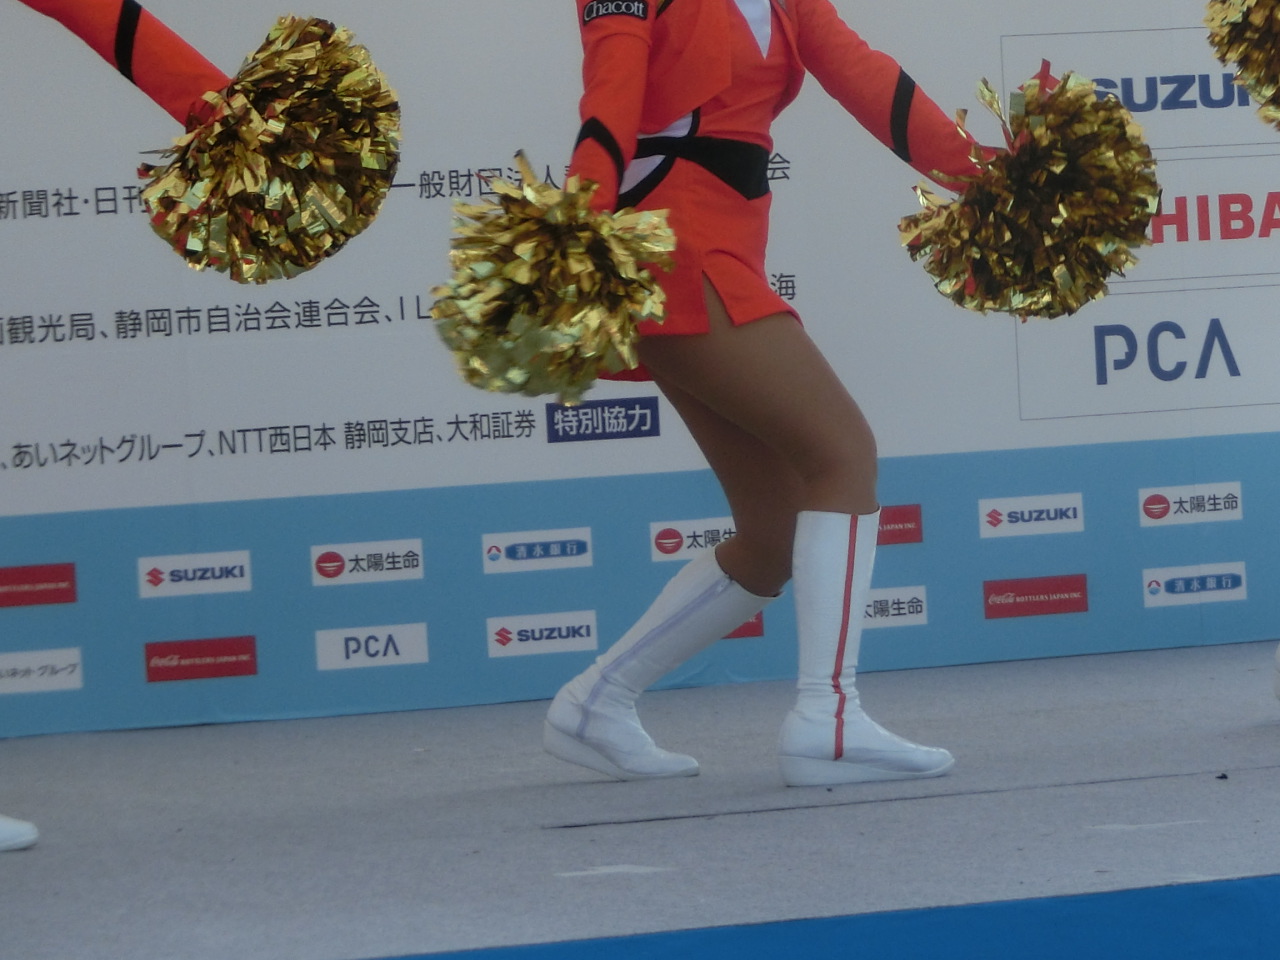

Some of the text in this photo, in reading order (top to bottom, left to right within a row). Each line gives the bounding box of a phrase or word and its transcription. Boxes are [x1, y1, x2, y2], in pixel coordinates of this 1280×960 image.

[1093, 318, 1241, 385] PCA
[343, 408, 537, 450] 静岡支店、大和証券
[553, 404, 652, 437] 特別協力
[1007, 506, 1078, 524] SUZUKI
[1173, 492, 1239, 515] 太陽生命
[169, 564, 245, 583] SUZUKI
[347, 549, 420, 574] 太陽生命
[517, 624, 591, 642] SUZUKI
[343, 634, 399, 660] PCA
